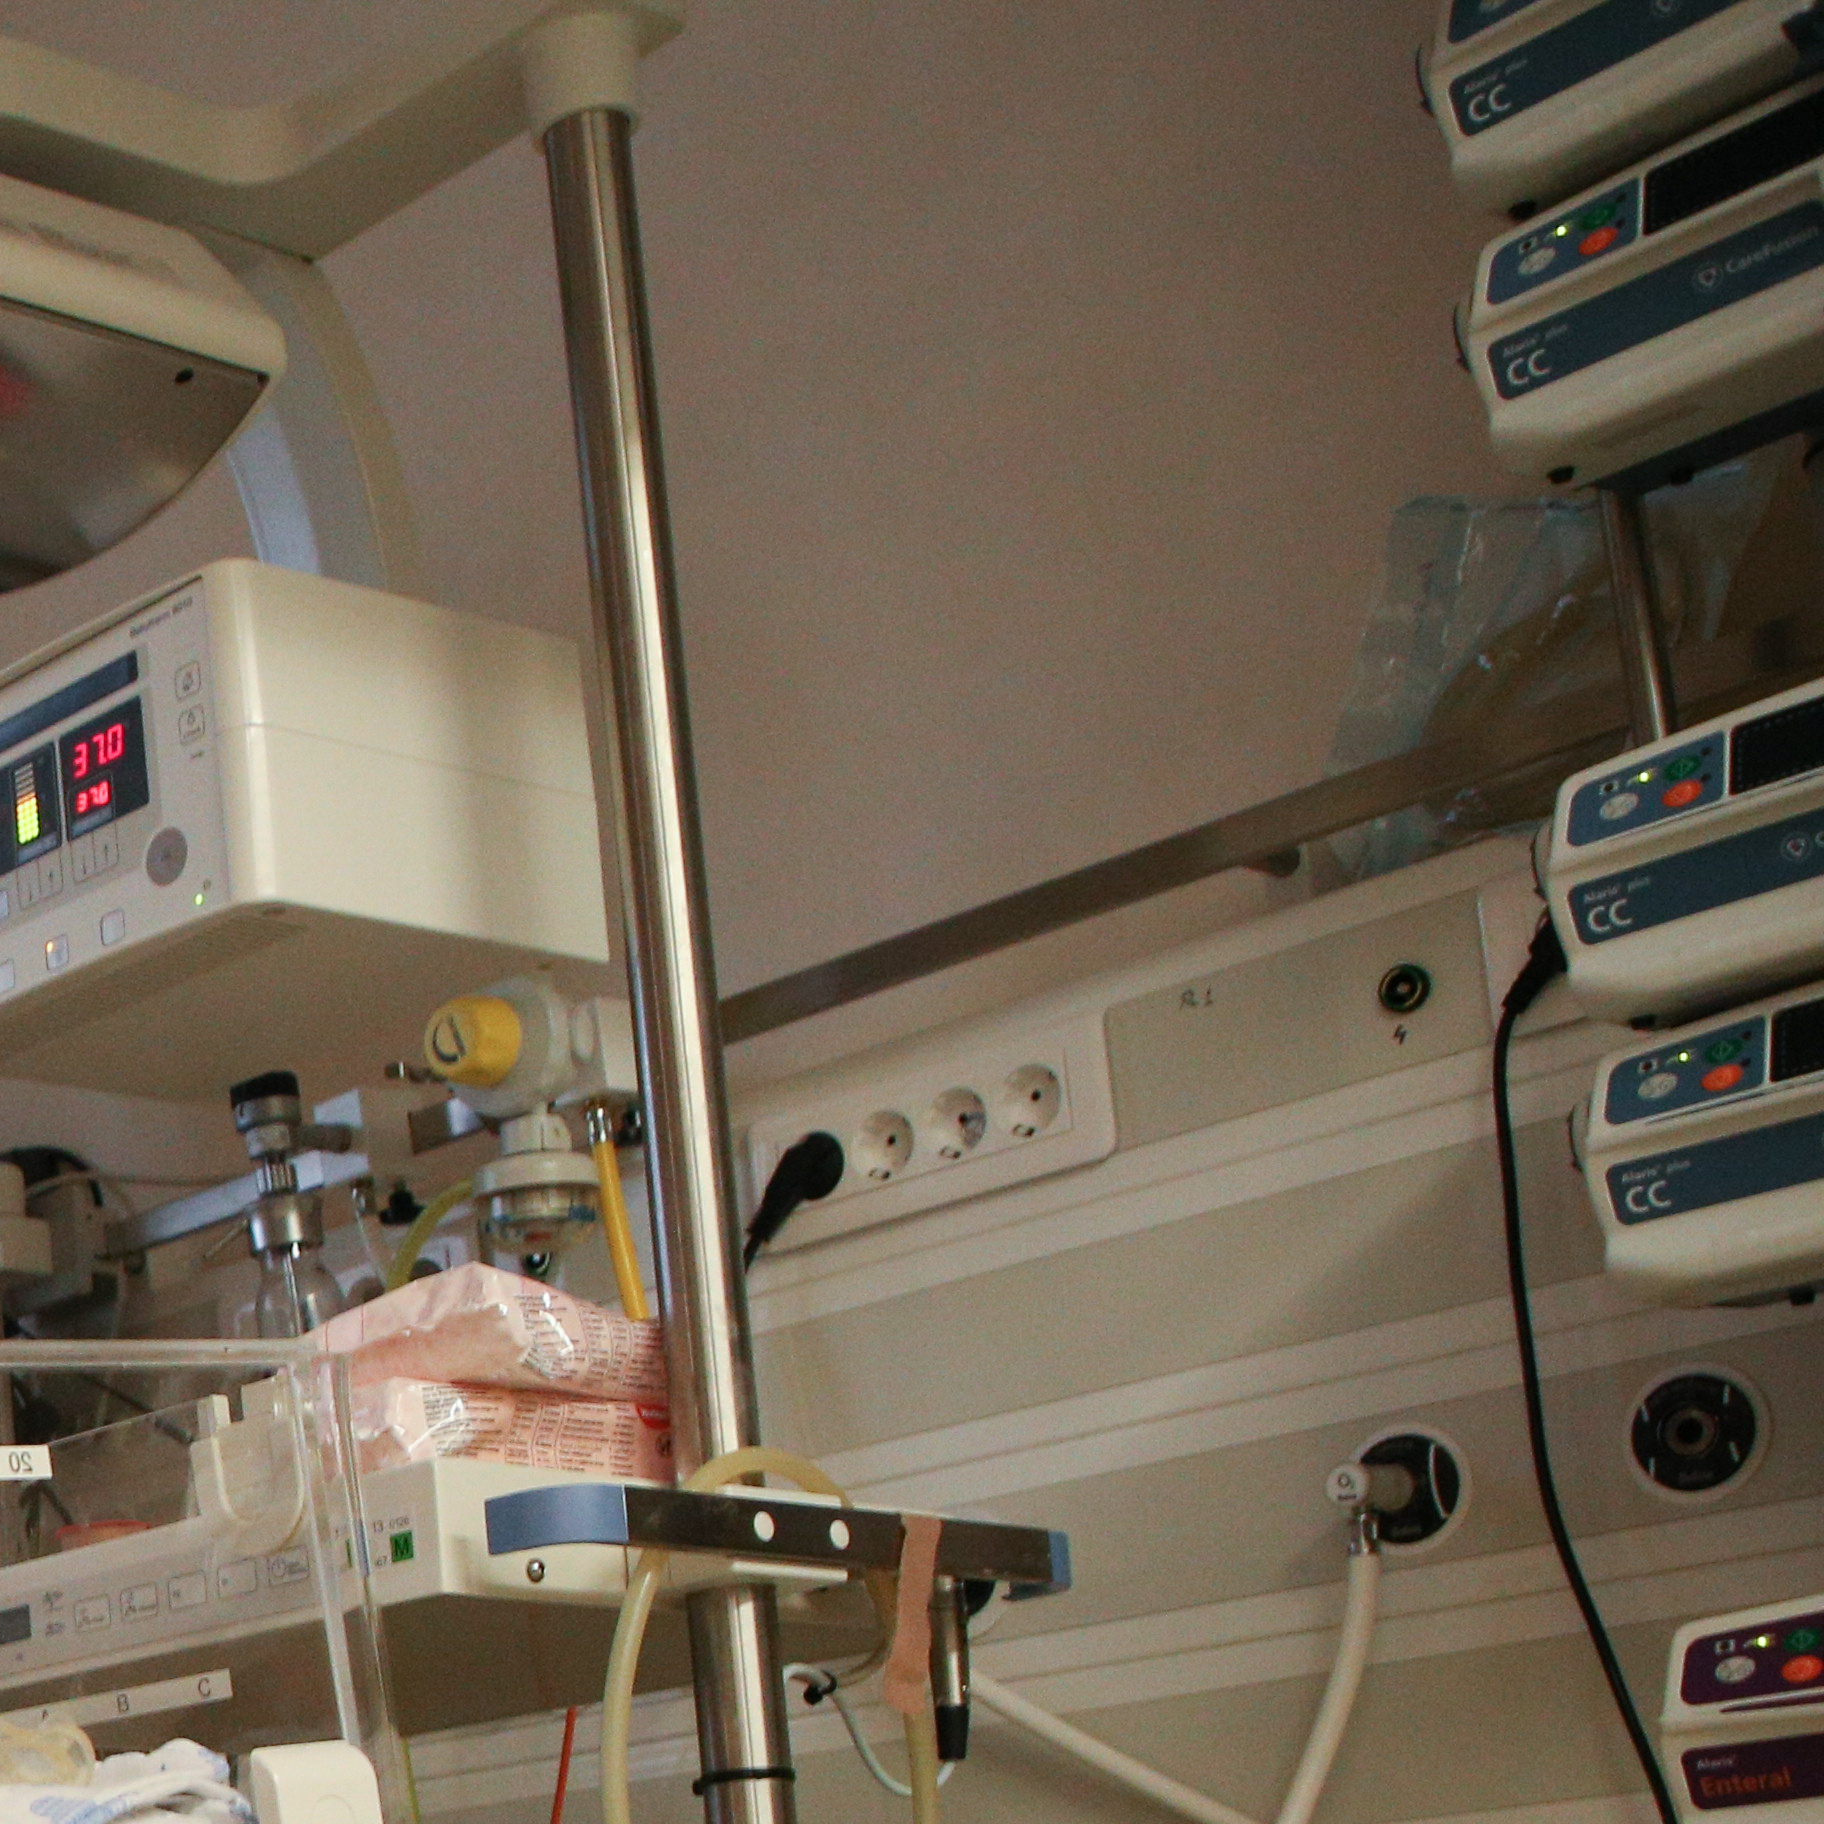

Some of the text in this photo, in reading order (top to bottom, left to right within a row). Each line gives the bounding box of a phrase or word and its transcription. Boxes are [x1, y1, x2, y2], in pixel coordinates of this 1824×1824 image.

[1467, 85, 1512, 124] CC
[1506, 348, 1551, 387] CC
[72, 722, 126, 780] 37.0
[1586, 898, 1634, 935] CC
[1624, 1178, 1672, 1214] CC
[394, 1536, 410, 1557] M
[115, 1691, 131, 1715] B
[196, 1676, 213, 1699] C
[1699, 1767, 1793, 1799] Enteral
